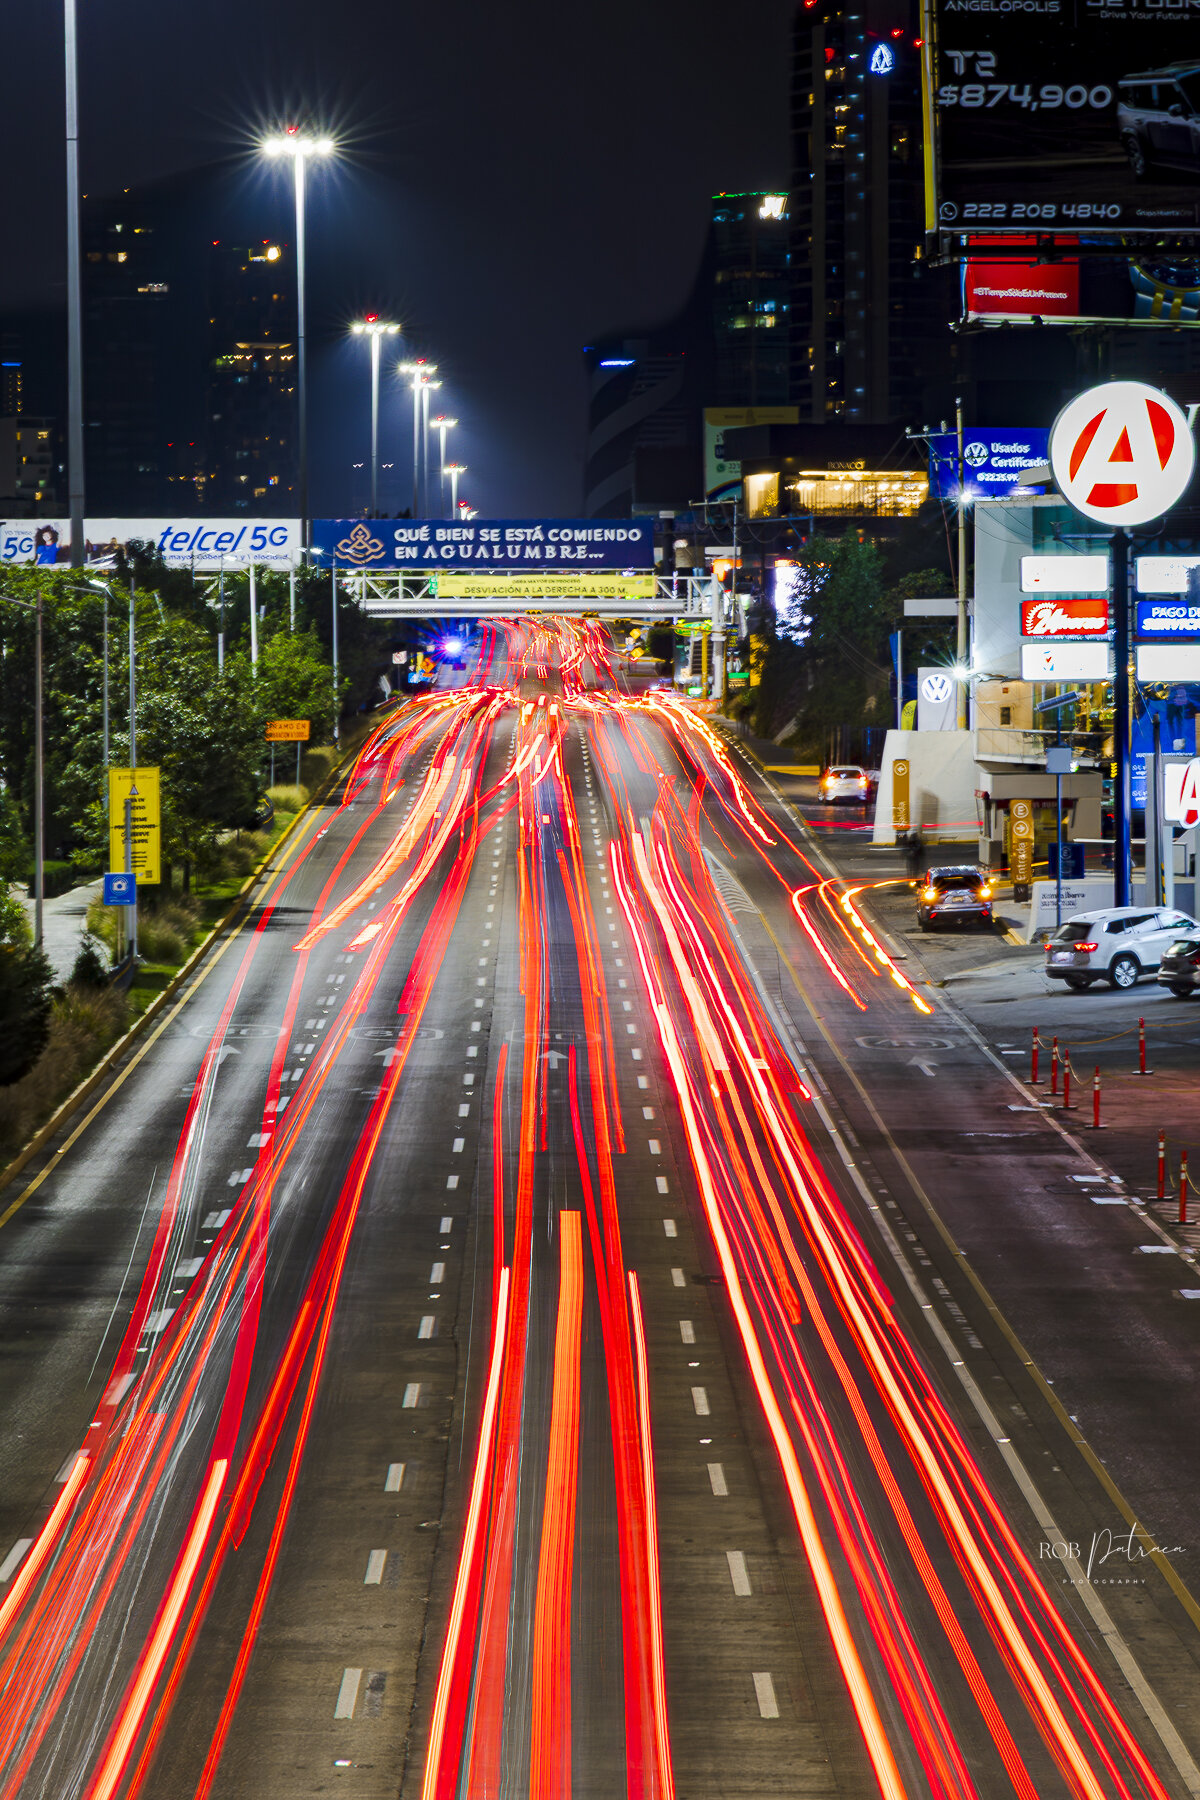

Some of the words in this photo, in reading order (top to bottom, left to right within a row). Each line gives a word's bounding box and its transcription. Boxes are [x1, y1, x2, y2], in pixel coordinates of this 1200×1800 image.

[944, 0, 1060, 12] ANGELOPOLIS
[1100, 10, 1127, 20] Drive
[1129, 11, 1155, 20] Your
[1156, 12, 1190, 21] Future
[944, 50, 998, 77] T2
[938, 84, 1112, 111] $874,900
[963, 204, 1006, 218] 222
[1011, 204, 1056, 218] 208
[1062, 204, 1121, 219] 4840
[991, 443, 1030, 453] Usados
[157, 526, 248, 553] telcel
[249, 526, 288, 551] 5G
[394, 525, 430, 543] QUÉ
[436, 529, 475, 541] BIEN
[479, 529, 501, 541] SE
[505, 525, 544, 541] ESTÁ
[548, 528, 642, 541] COMIENDO
[2, 537, 33, 559] 5G
[395, 546, 418, 559] EN
[464, 585, 521, 594] DESVIACIÓN
[1152, 606, 1187, 618] PAGO
[1016, 842, 1027, 881] Entrada
